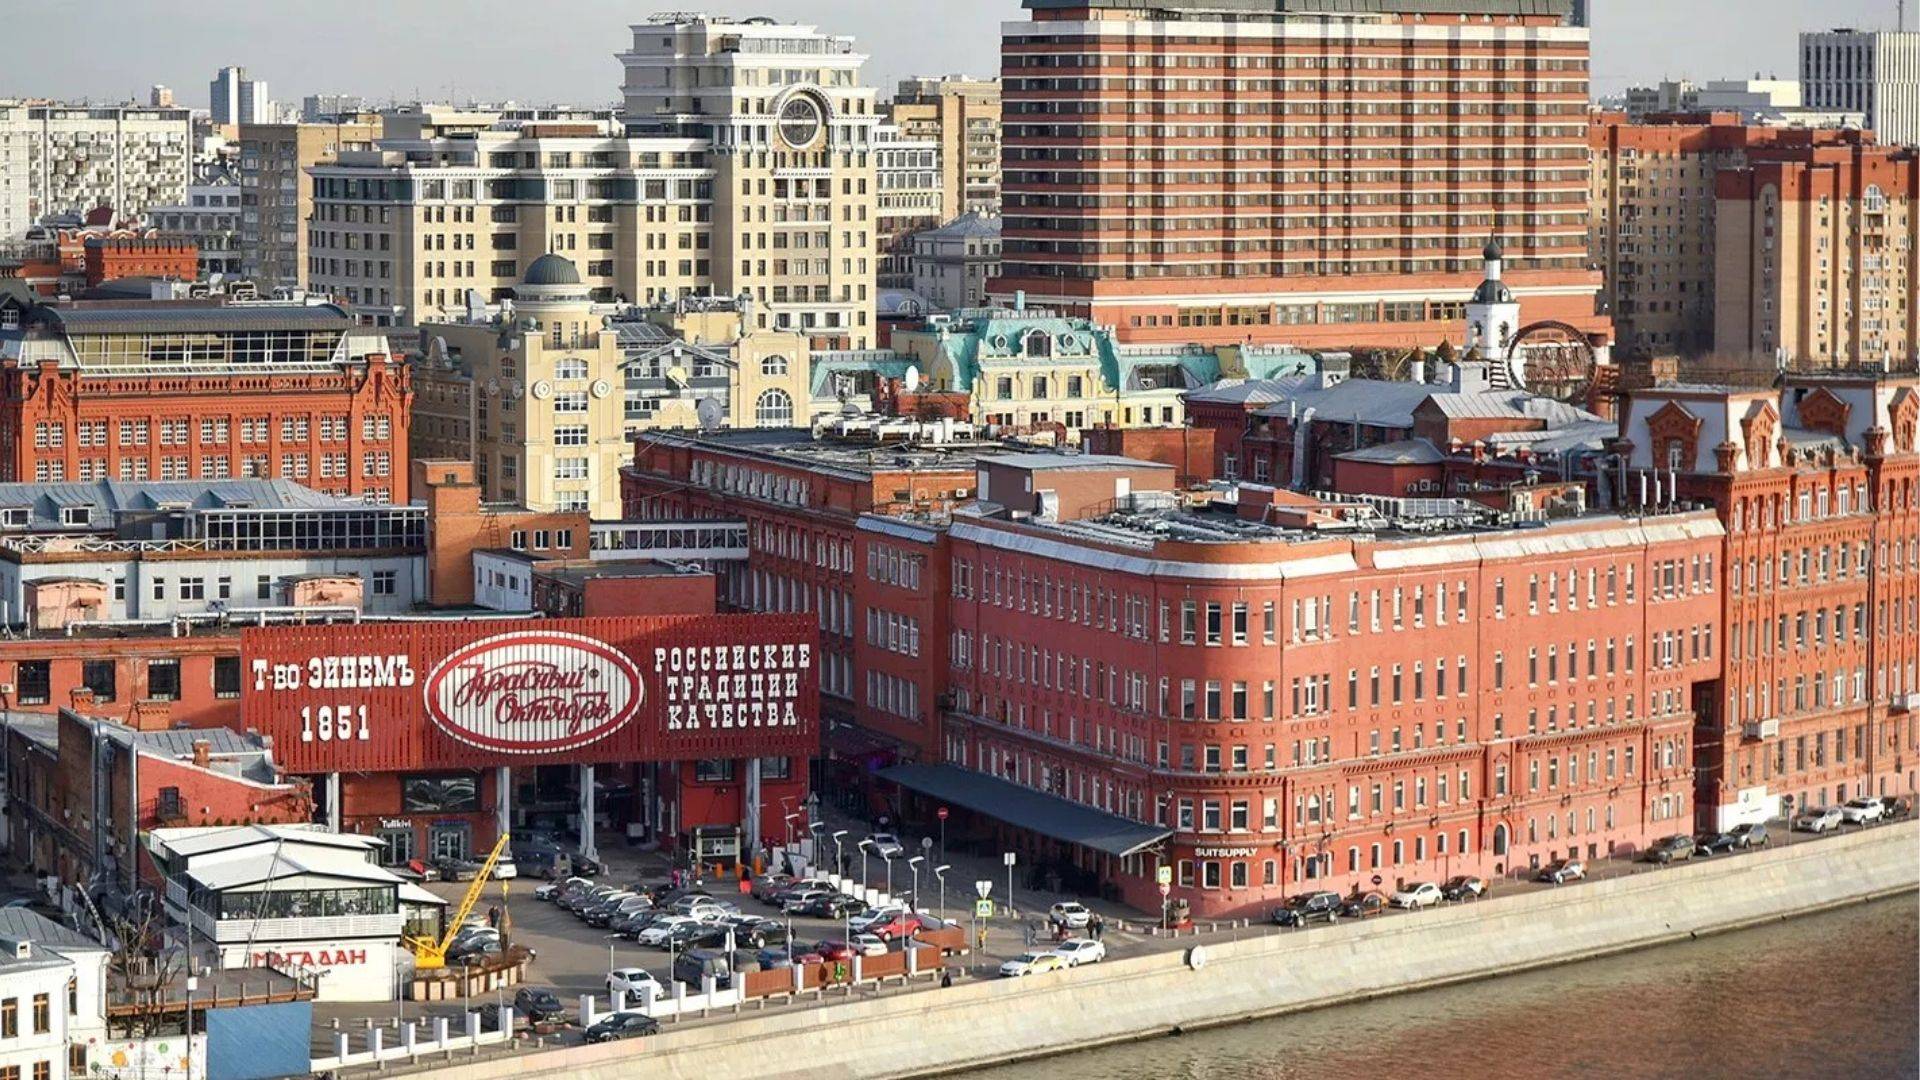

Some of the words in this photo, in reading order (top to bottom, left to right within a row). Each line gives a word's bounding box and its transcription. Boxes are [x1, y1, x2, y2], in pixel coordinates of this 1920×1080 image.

[654, 643, 810, 672] РОССИЙСКИЕ
[252, 659, 300, 691] Т-во
[308, 655, 415, 689] ЭЙНЕМЪ
[454, 661, 588, 708] Красный
[666, 673, 798, 702] ТРАДИЦИИ
[301, 704, 370, 742] 1851
[494, 692, 612, 735] Октябрь
[668, 702, 797, 730] КАЧЕСТВА
[1195, 847, 1258, 857] SUITSUPPLY
[253, 949, 366, 967] МАГАДАН
